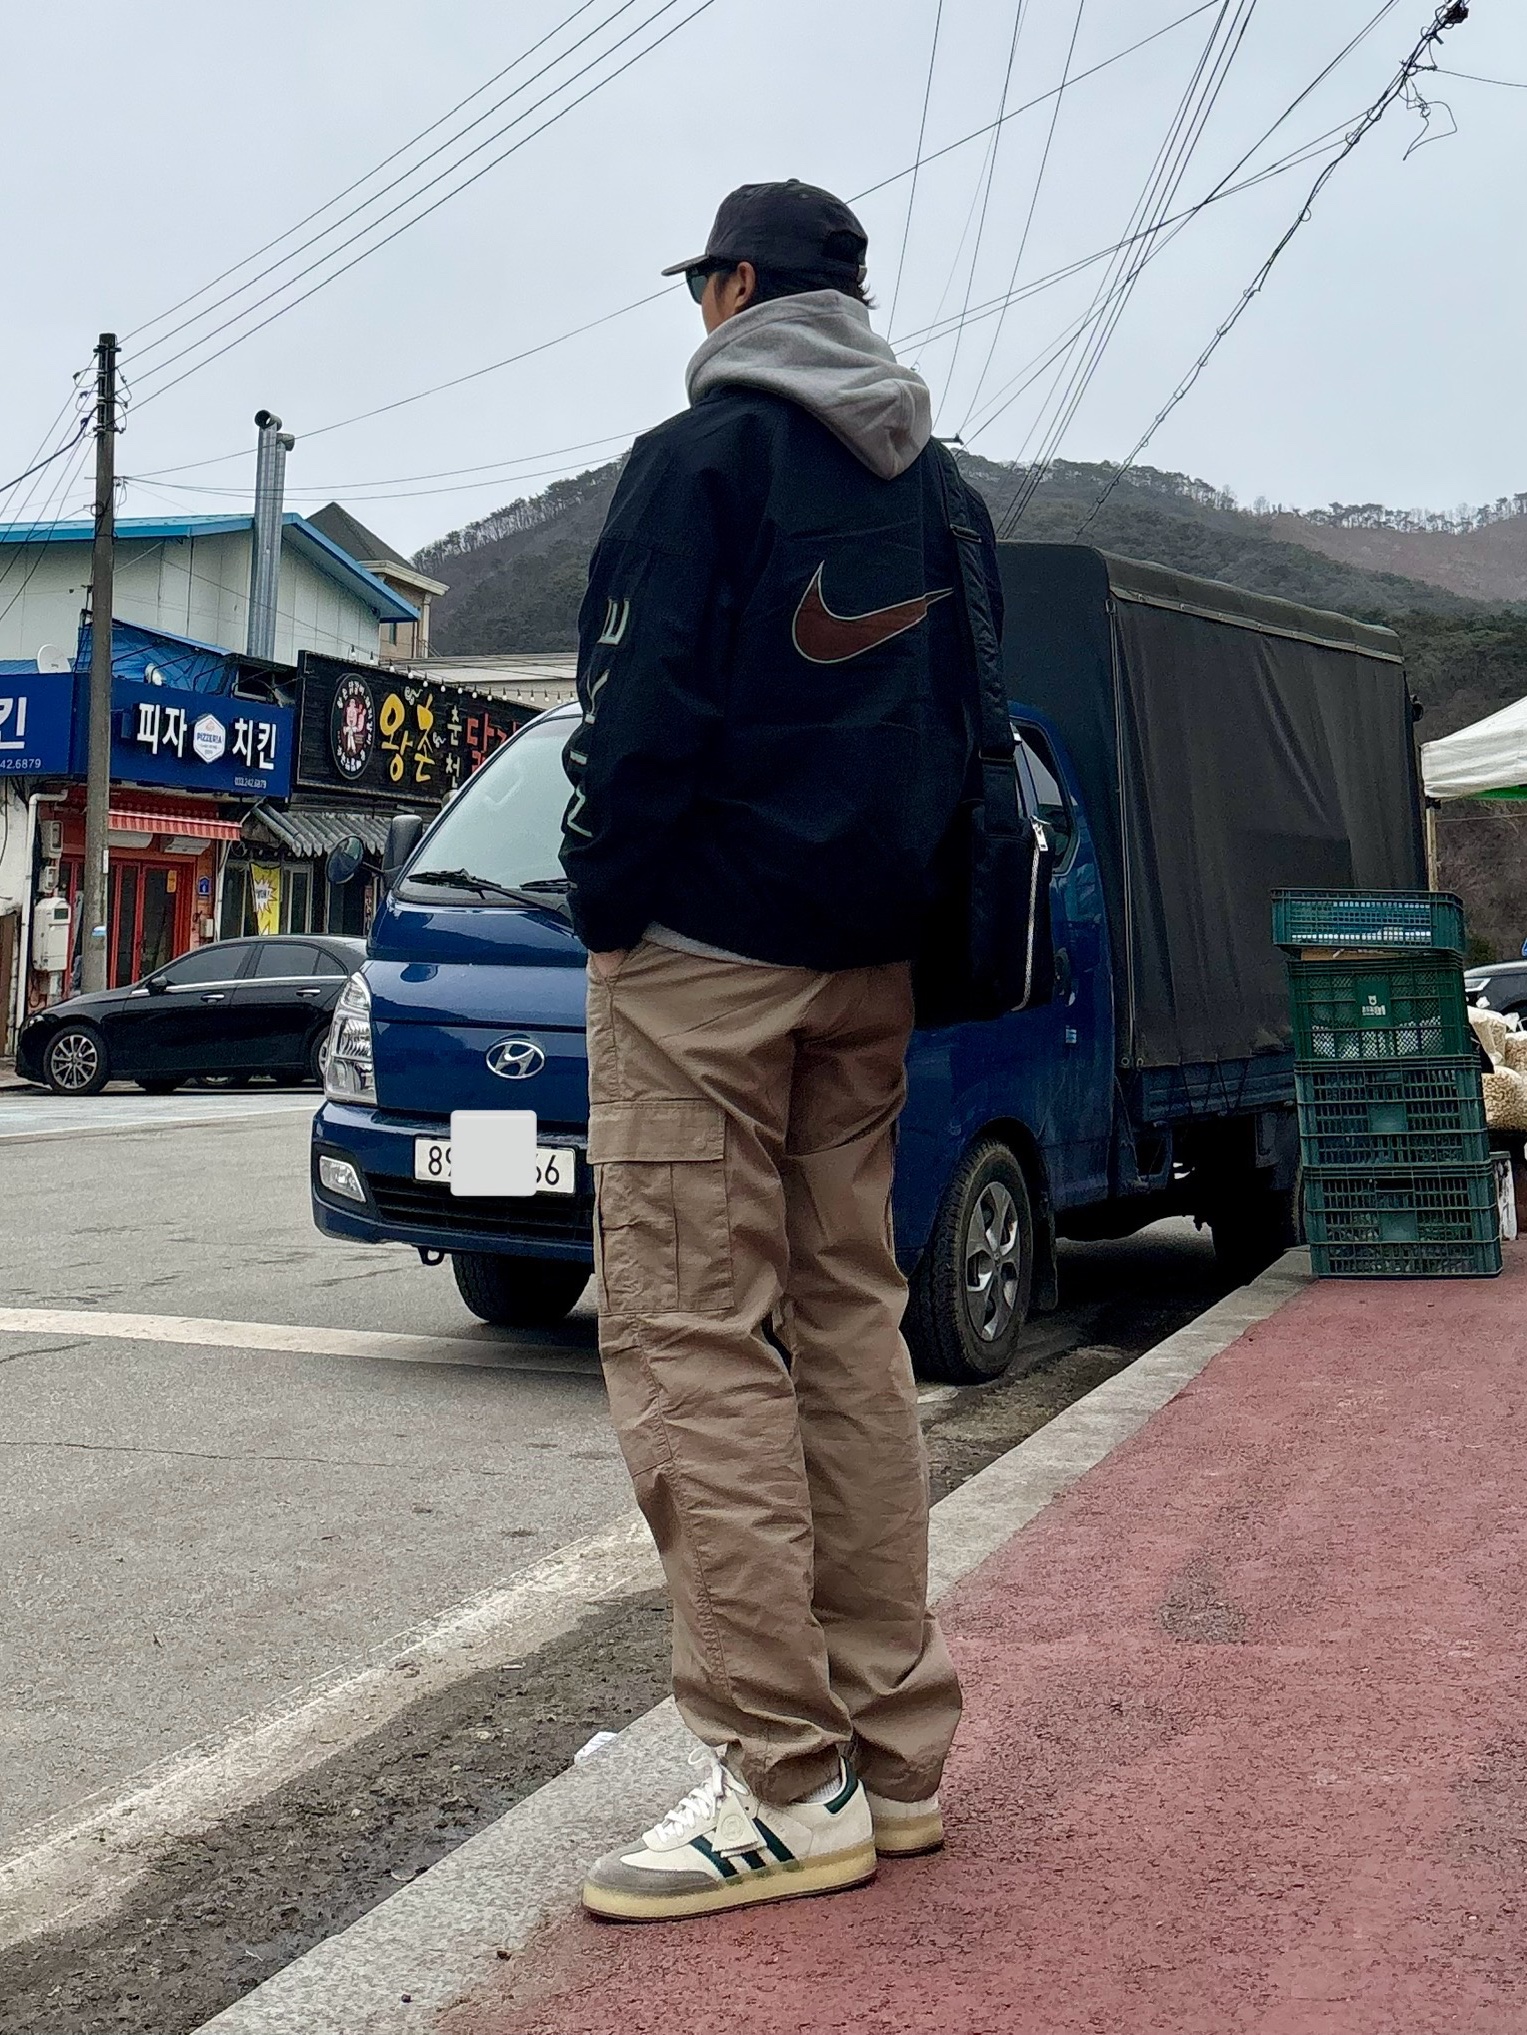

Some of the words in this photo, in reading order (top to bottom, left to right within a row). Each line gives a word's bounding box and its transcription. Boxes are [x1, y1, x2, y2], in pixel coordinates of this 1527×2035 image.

[137, 703, 188, 758] 피자
[232, 717, 277, 770] 치킨
[196, 732, 222, 743] PIZZERIA
[445, 705, 462, 788] 춘천
[467, 713, 517, 774] 닭
